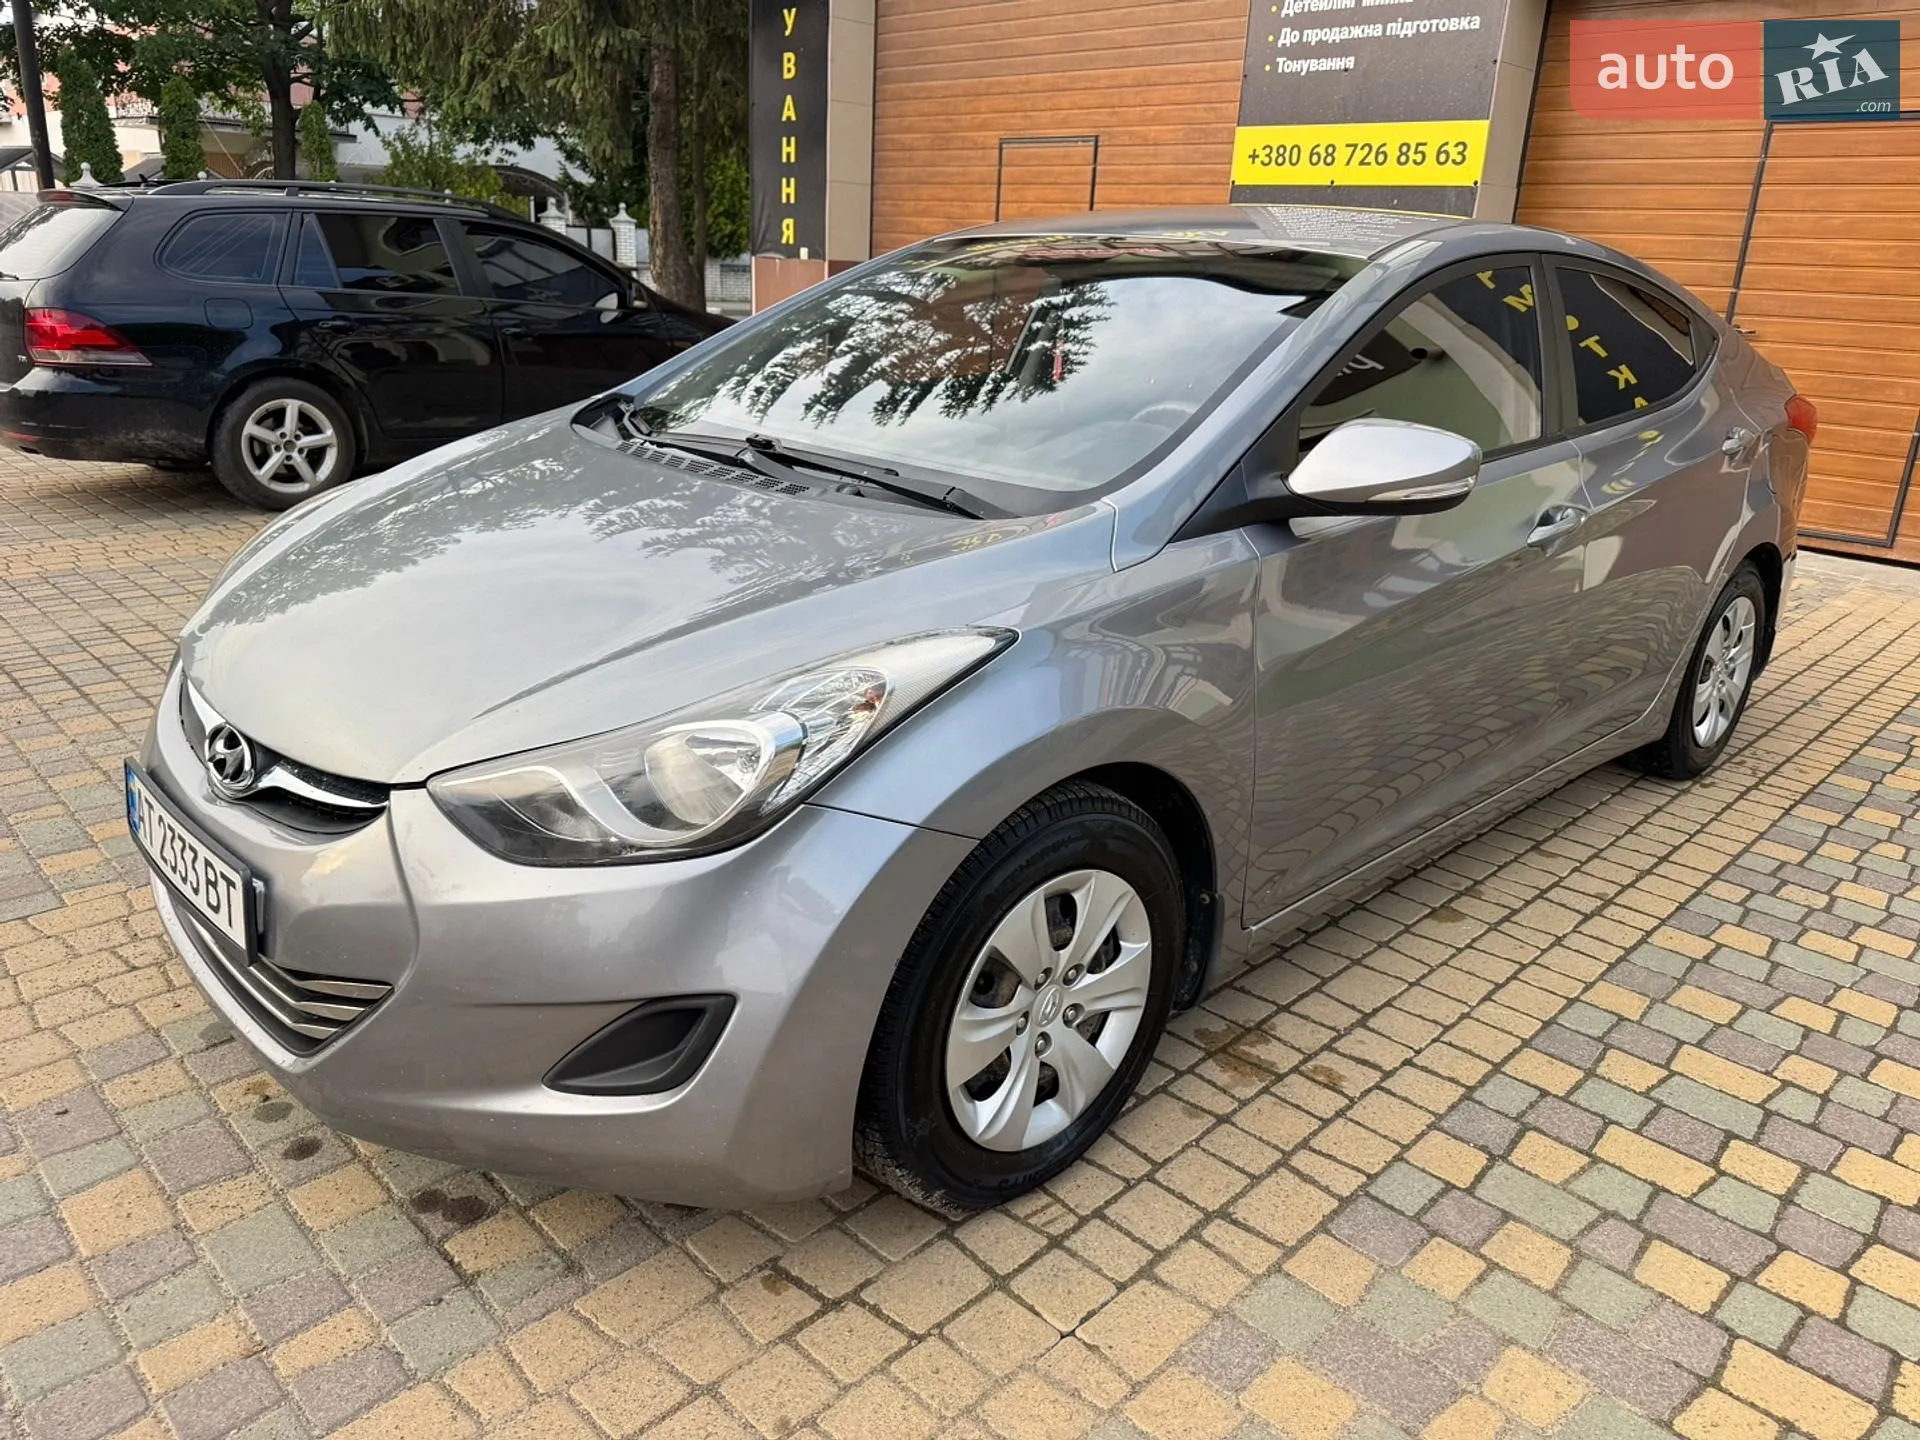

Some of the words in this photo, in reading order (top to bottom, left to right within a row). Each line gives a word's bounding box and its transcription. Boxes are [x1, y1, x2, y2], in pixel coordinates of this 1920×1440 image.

[1278, 27, 1300, 47] До
[1303, 23, 1382, 45] продажна
[1386, 15, 1481, 38] підготовка
[1276, 55, 1355, 75] Тонування
[780, 7, 797, 245] УВАННЯ
[1248, 143, 1301, 167] +380
[1309, 143, 1336, 166] 68
[1344, 142, 1389, 166] 726
[1396, 141, 1428, 166] 85
[1435, 141, 1468, 165] 63
[158, 814, 200, 896] 2333
[203, 856, 236, 929] BT
